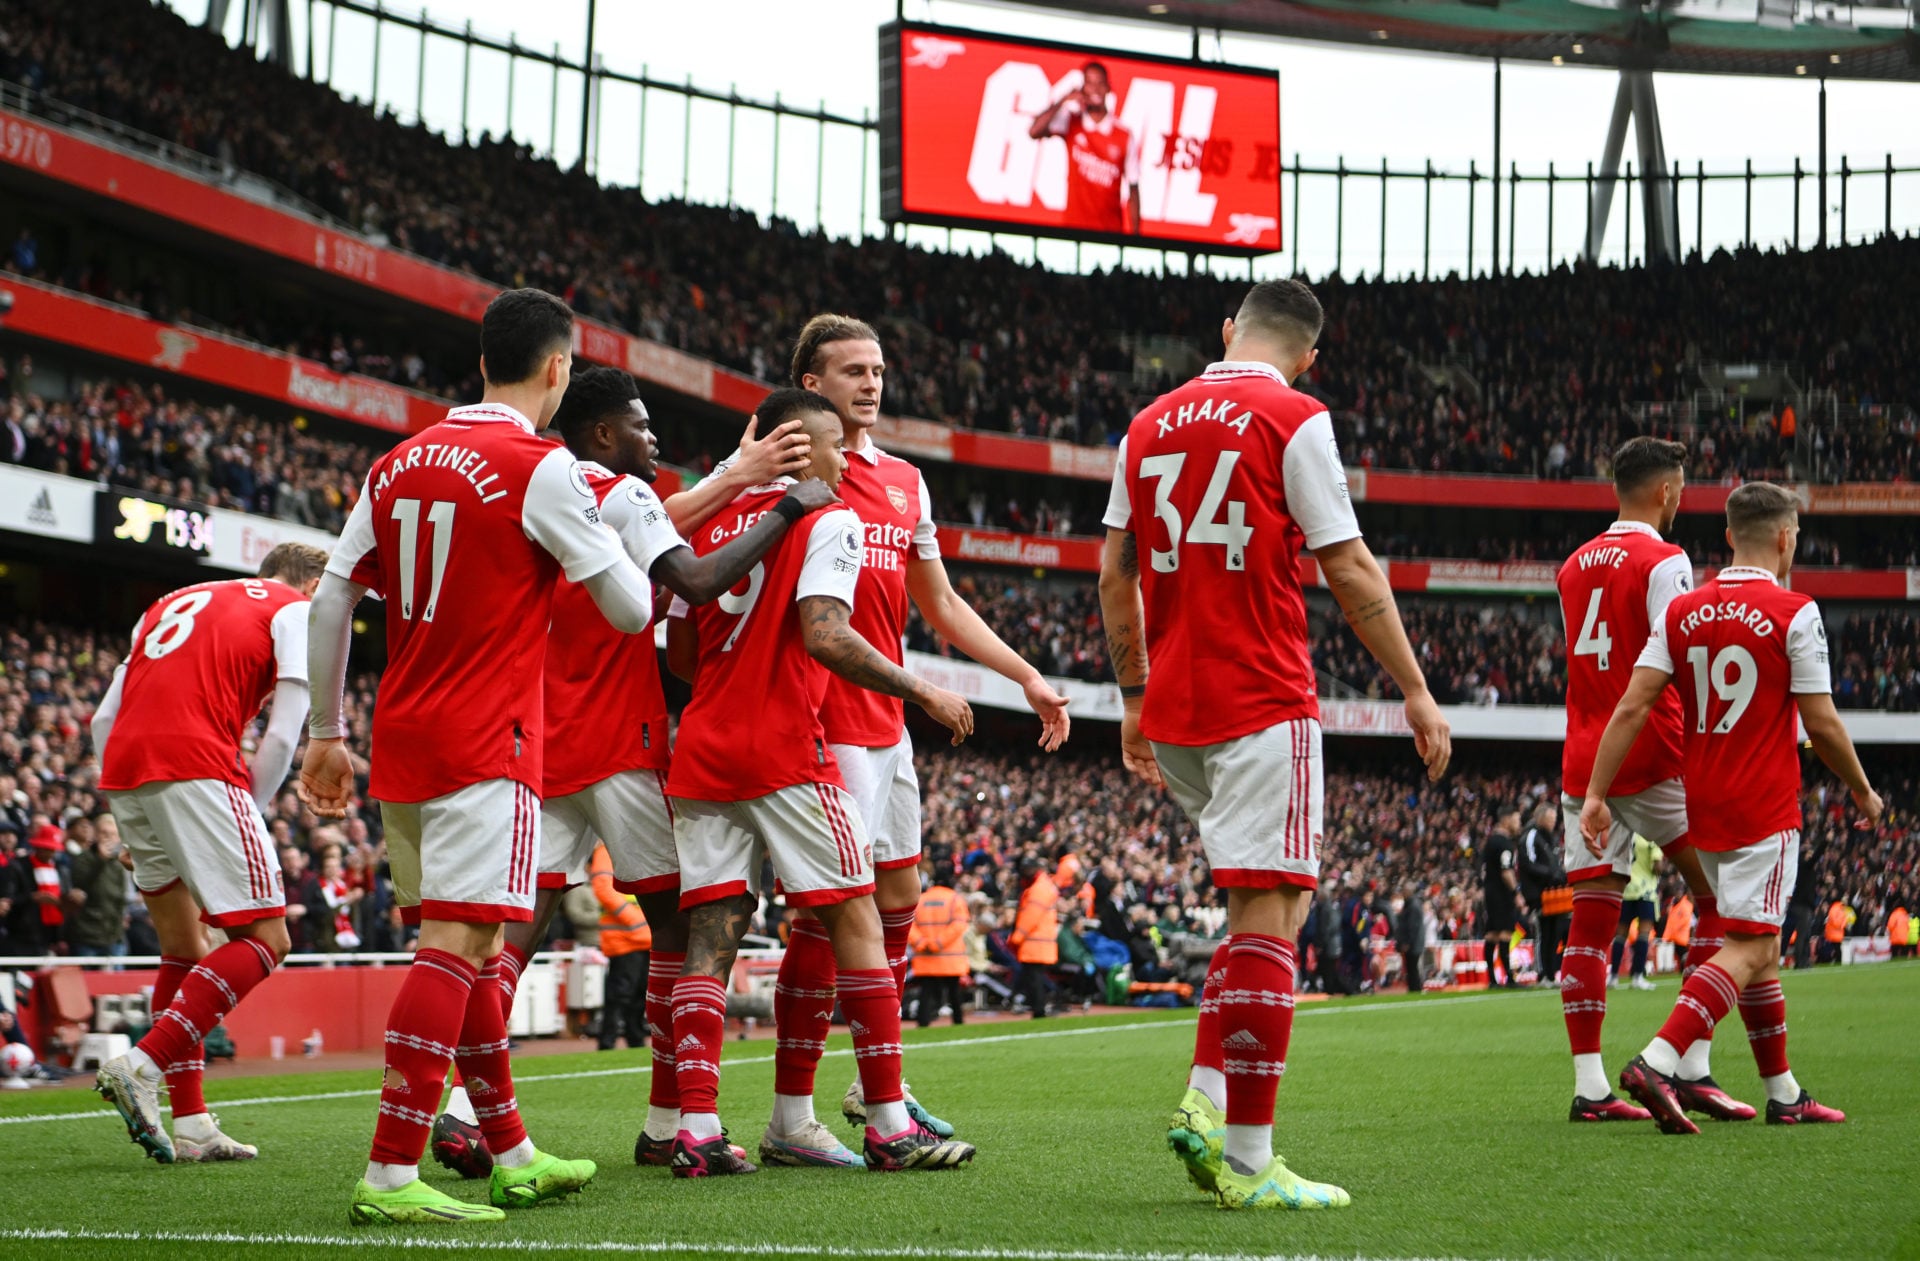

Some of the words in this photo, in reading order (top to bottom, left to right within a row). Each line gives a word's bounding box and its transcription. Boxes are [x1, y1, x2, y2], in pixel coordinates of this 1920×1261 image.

[1156, 398, 1252, 439] XHAKA
[374, 444, 509, 504] MARTINELLI
[861, 521, 912, 550] rates
[1138, 450, 1255, 573] 34
[390, 498, 456, 623] 11
[861, 546, 898, 571] ETTER
[957, 530, 1061, 566] Arsenal.com
[1578, 546, 1629, 572] WHITE
[143, 589, 213, 660] 8
[717, 560, 765, 652] 9
[1573, 586, 1613, 672] 4
[1679, 601, 1774, 638] TROSSARD
[1686, 644, 1759, 734] 19
